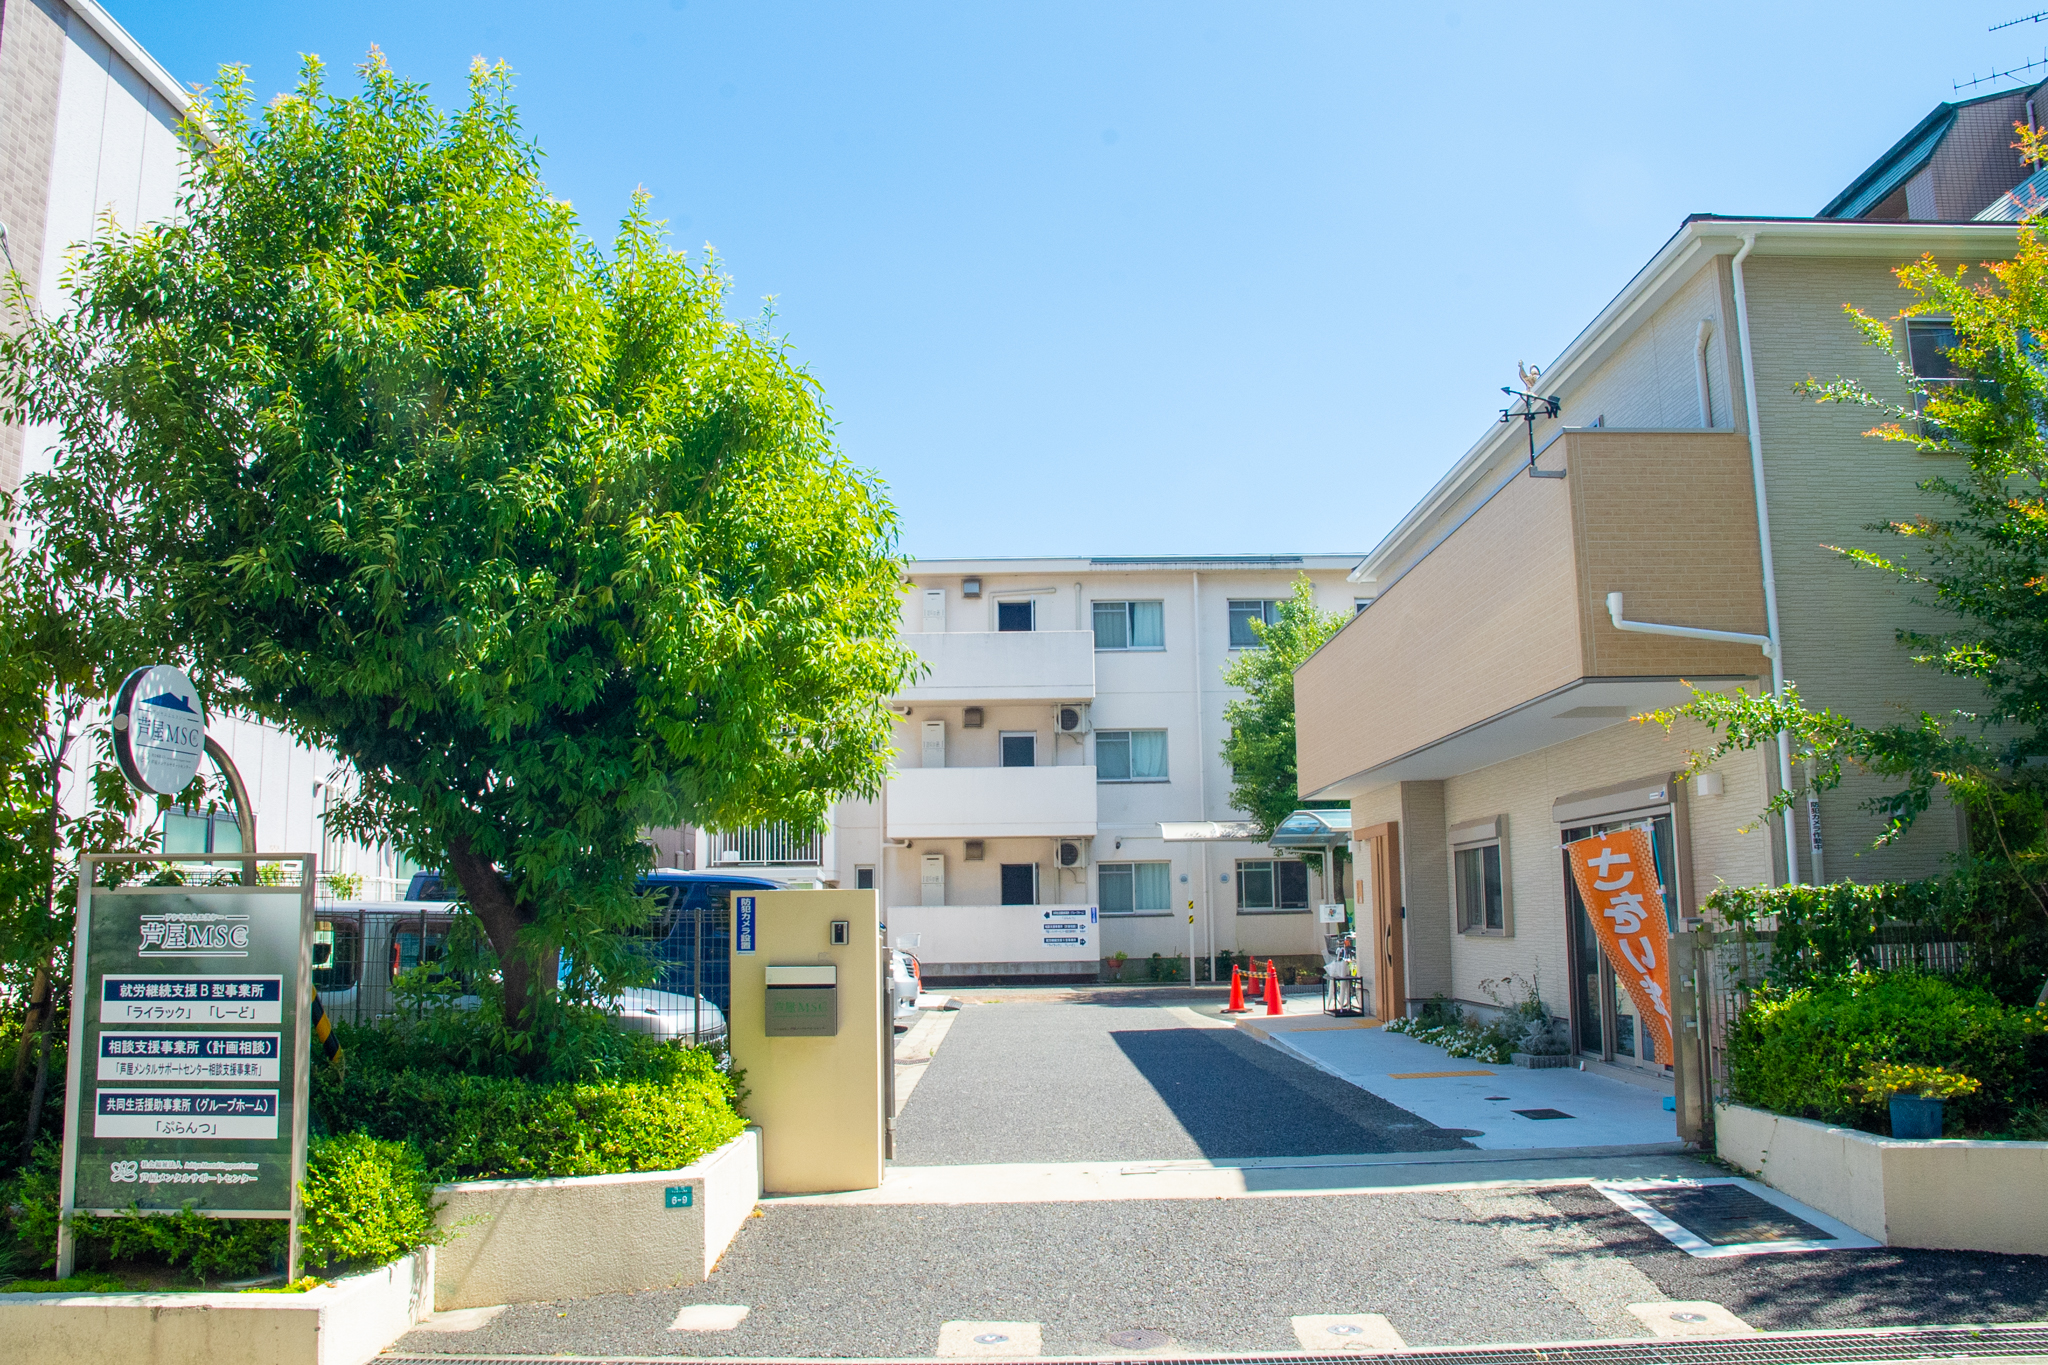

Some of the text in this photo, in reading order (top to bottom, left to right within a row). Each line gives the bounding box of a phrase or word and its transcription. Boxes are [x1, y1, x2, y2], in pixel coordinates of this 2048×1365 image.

[137, 715, 199, 748] 芦屋MSC
[741, 897, 751, 950] 防犯カメラ設置
[139, 922, 249, 950] 芦屋MSC
[119, 983, 265, 998] 就労継続支援B型事業所
[127, 1005, 255, 1020] 「ライラック」 「しーど」
[109, 1040, 272, 1055] 相談支援事業所（計画相談）
[106, 1097, 269, 1113] 共同生活援助事業所（グループホーム）
[156, 1120, 217, 1135] 「ぷらんつ」
[671, 1195, 687, 1205] 6-9
